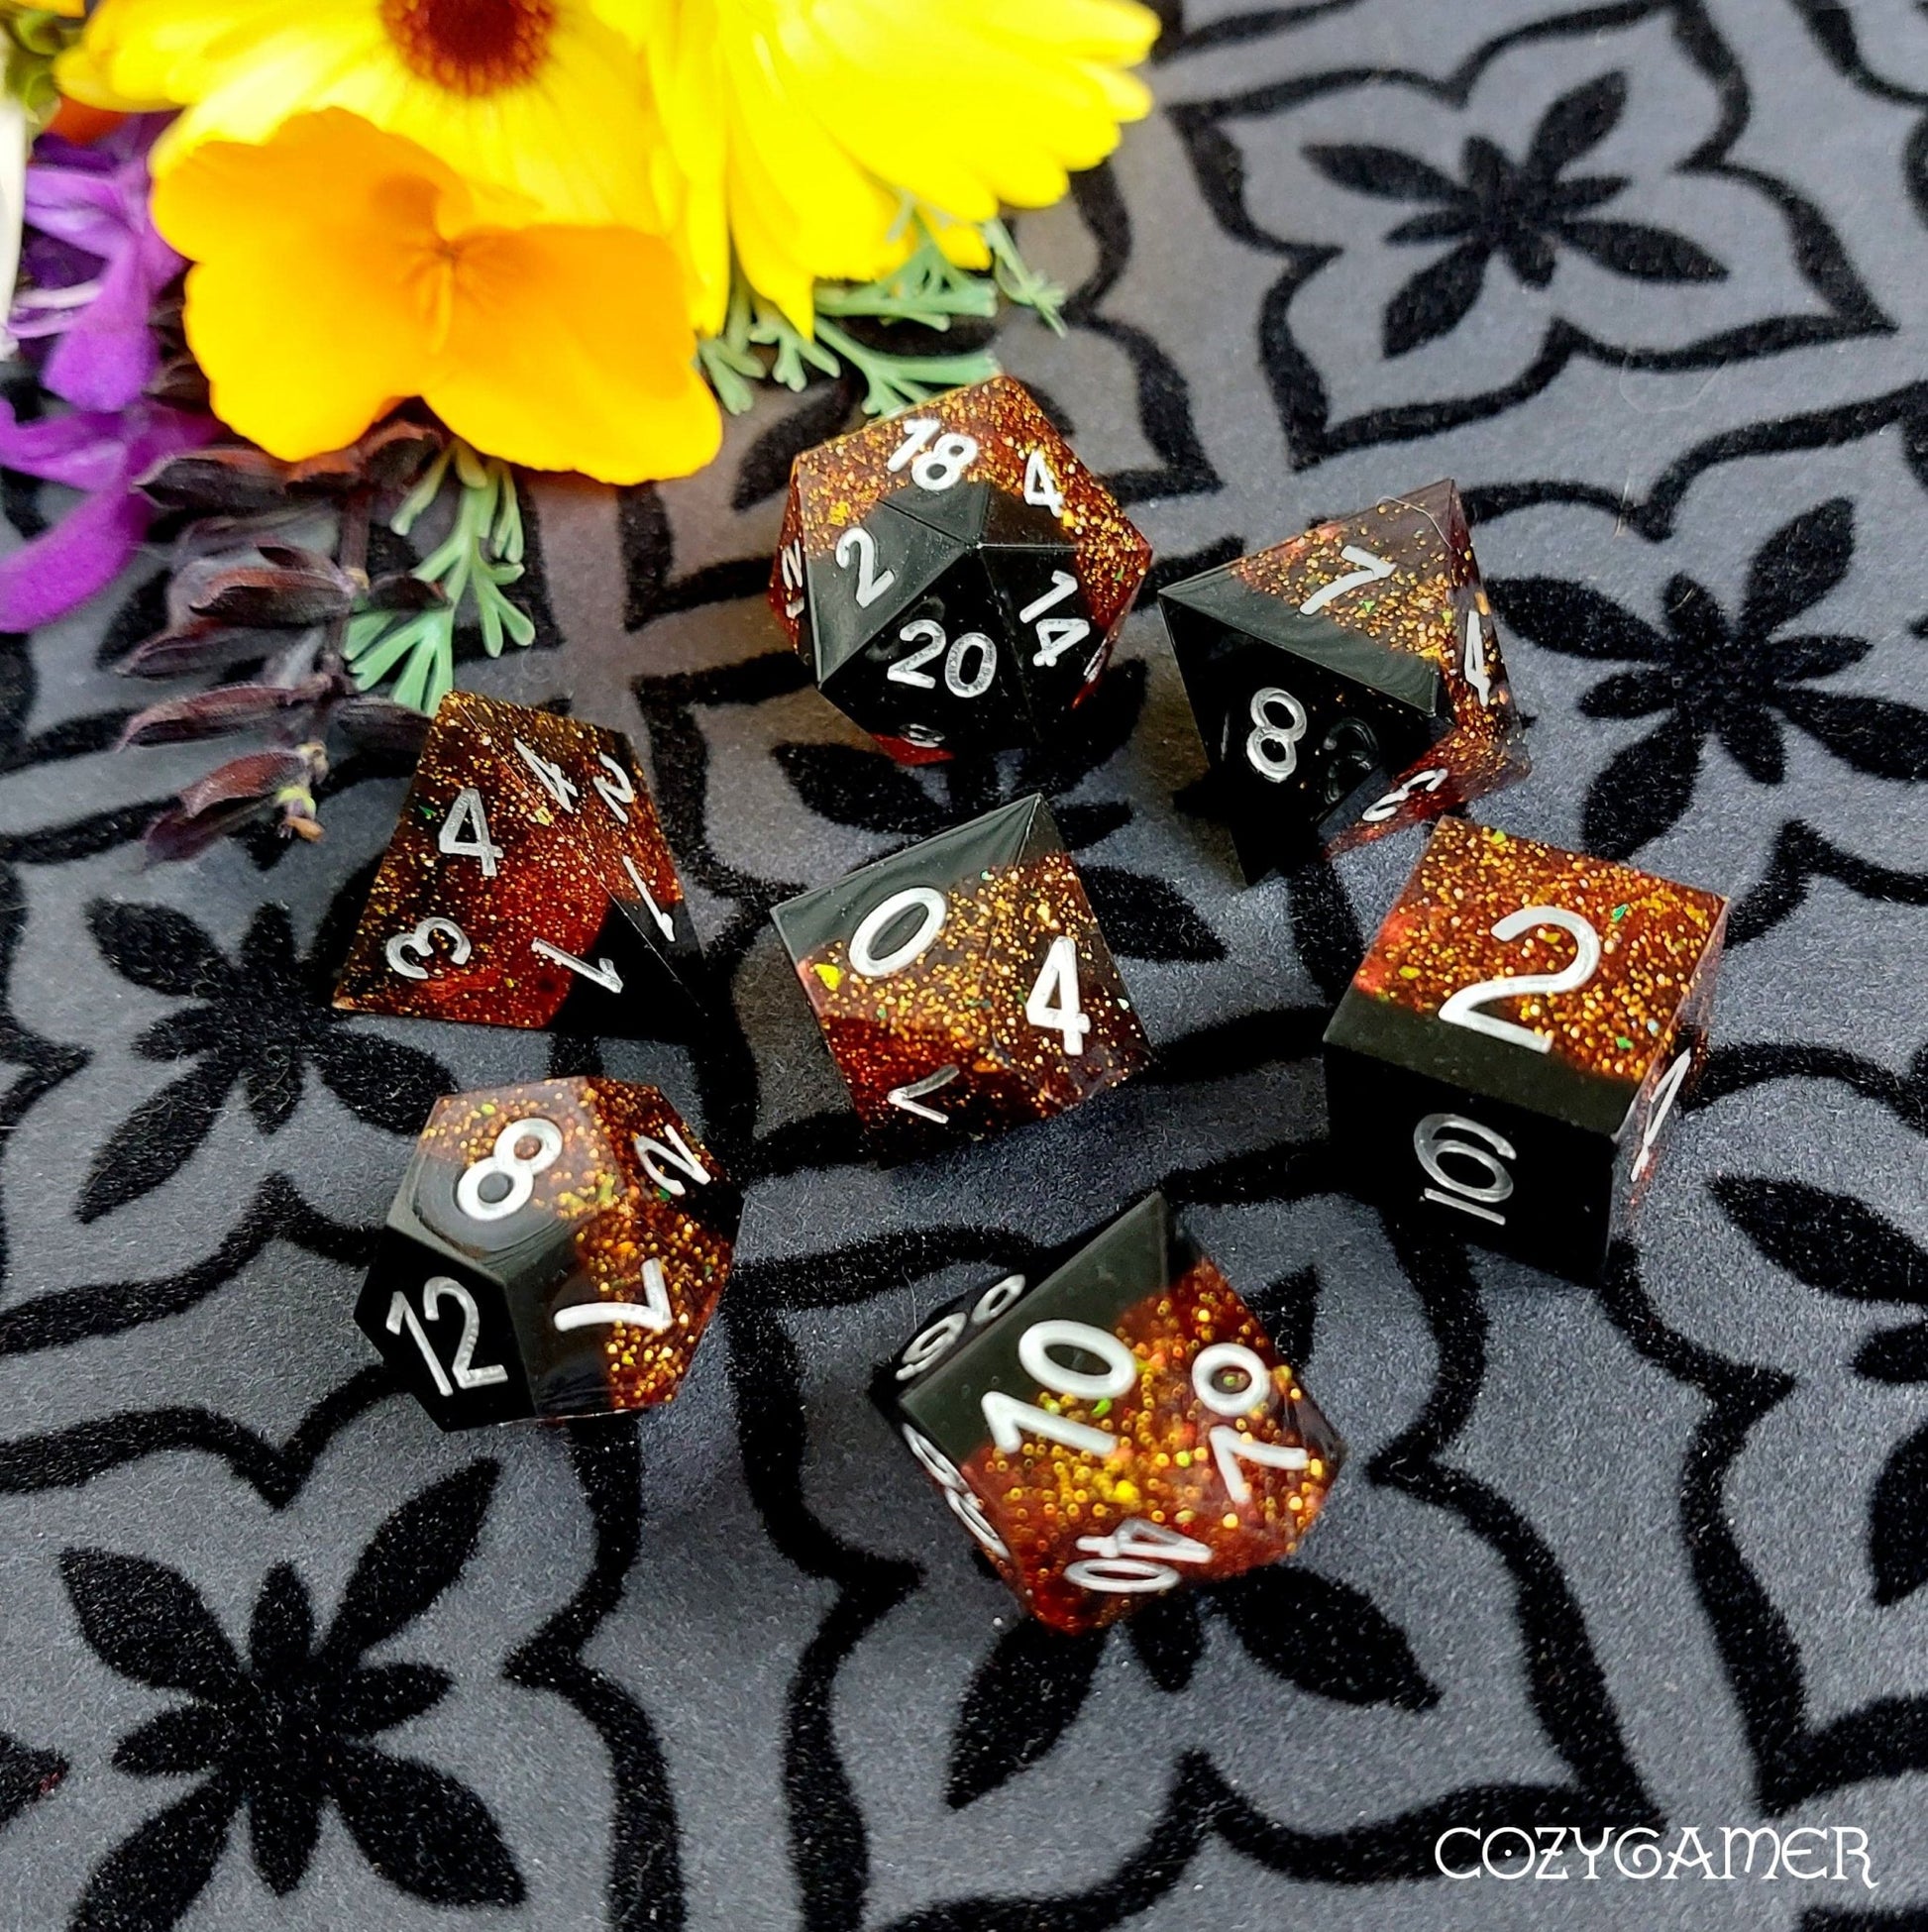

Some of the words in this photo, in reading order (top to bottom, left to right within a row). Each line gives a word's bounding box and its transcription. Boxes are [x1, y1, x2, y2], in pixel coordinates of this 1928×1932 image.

[888, 417, 979, 491] 18
[1022, 449, 1065, 518] 4
[835, 526, 897, 609] 2
[1299, 545, 1398, 616] 7
[887, 619, 998, 698] 20
[1018, 570, 1090, 667] 14
[1463, 610, 1491, 706] 4
[513, 737, 579, 814] 4
[1246, 687, 1307, 784] 8
[438, 787, 504, 878] 4
[622, 854, 677, 942] 1
[848, 887, 948, 978] 0
[385, 916, 472, 980] 3
[531, 936, 624, 994] 1
[1438, 905, 1601, 1055] 2
[1025, 934, 1091, 1056] 4
[457, 1117, 564, 1222] 8
[385, 1276, 509, 1397] 12
[553, 1257, 674, 1333] 7
[981, 1319, 1138, 1457] 10
[1192, 1342, 1310, 1506] 70
